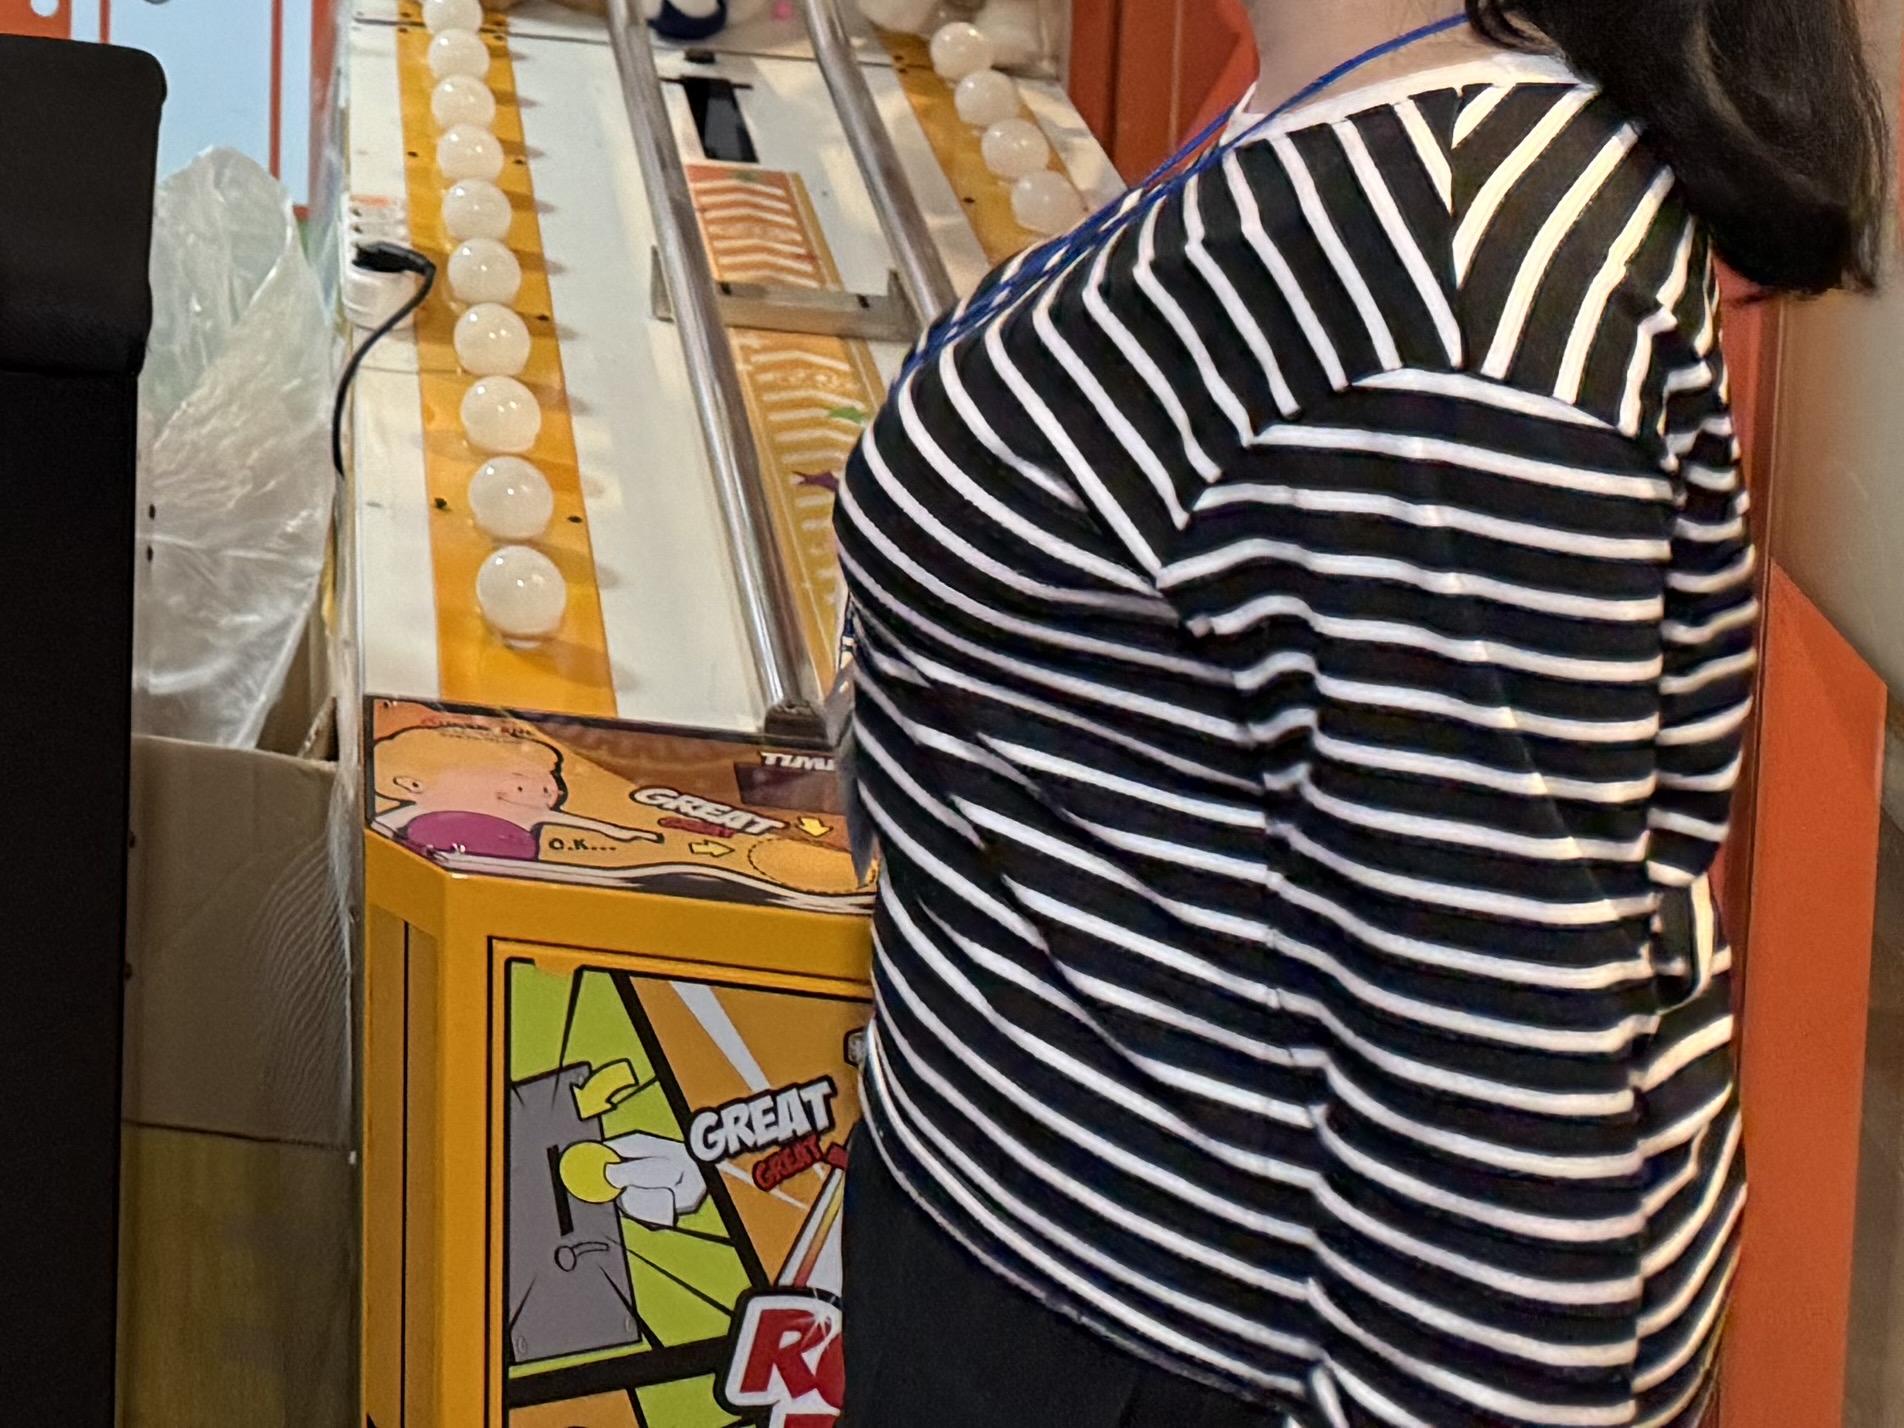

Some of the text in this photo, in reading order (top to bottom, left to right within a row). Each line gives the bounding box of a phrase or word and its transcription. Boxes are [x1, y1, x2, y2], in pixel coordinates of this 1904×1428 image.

[759, 751, 837, 772] TIM
[632, 785, 788, 834] GREAT
[689, 1079, 834, 1164] GREAT
[753, 1133, 824, 1191] GREAT
